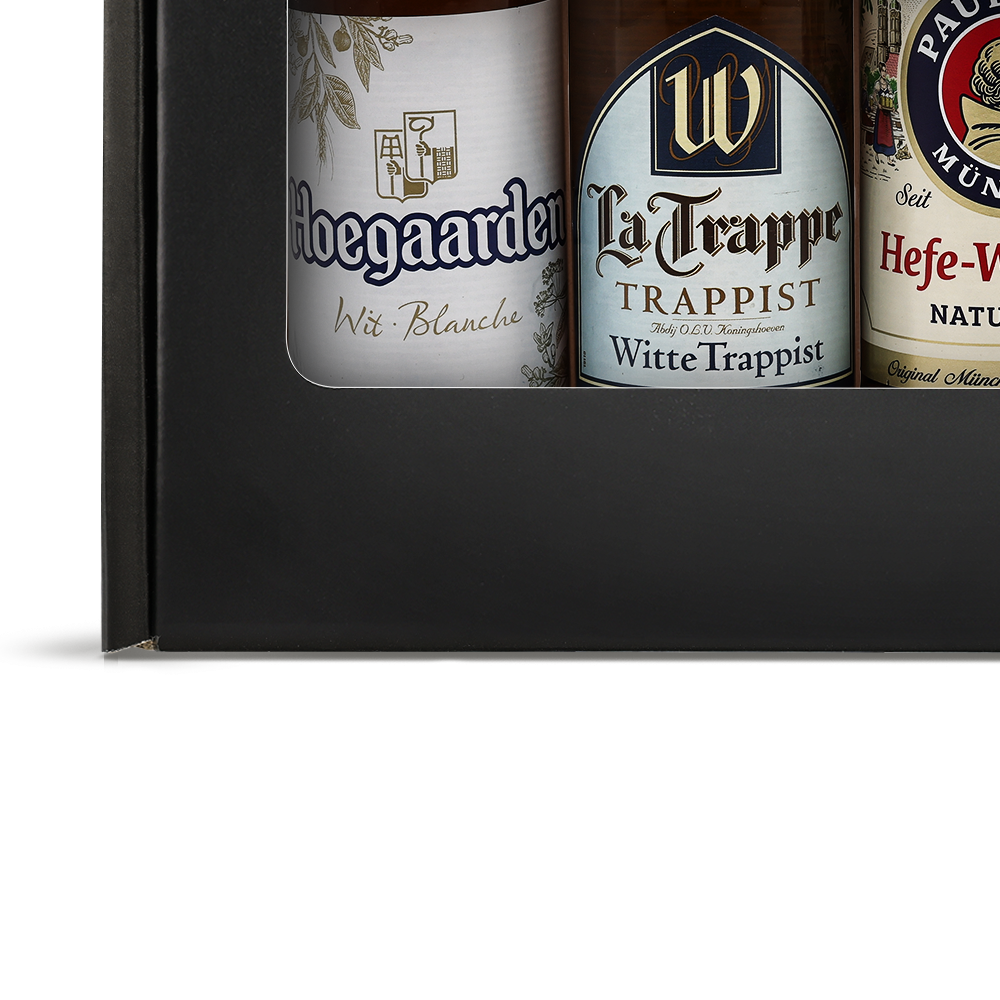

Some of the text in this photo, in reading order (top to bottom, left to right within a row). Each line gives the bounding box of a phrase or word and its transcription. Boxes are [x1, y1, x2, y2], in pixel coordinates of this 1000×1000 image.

[895, 183, 932, 210] Seit
[288, 176, 566, 286] Hoegaarden
[586, 183, 845, 278] La Trappe
[615, 278, 822, 315] TRAPPIST
[334, 296, 523, 341] Wit Blanche
[650, 322, 678, 338] Abdij
[887, 360, 941, 384] Original
